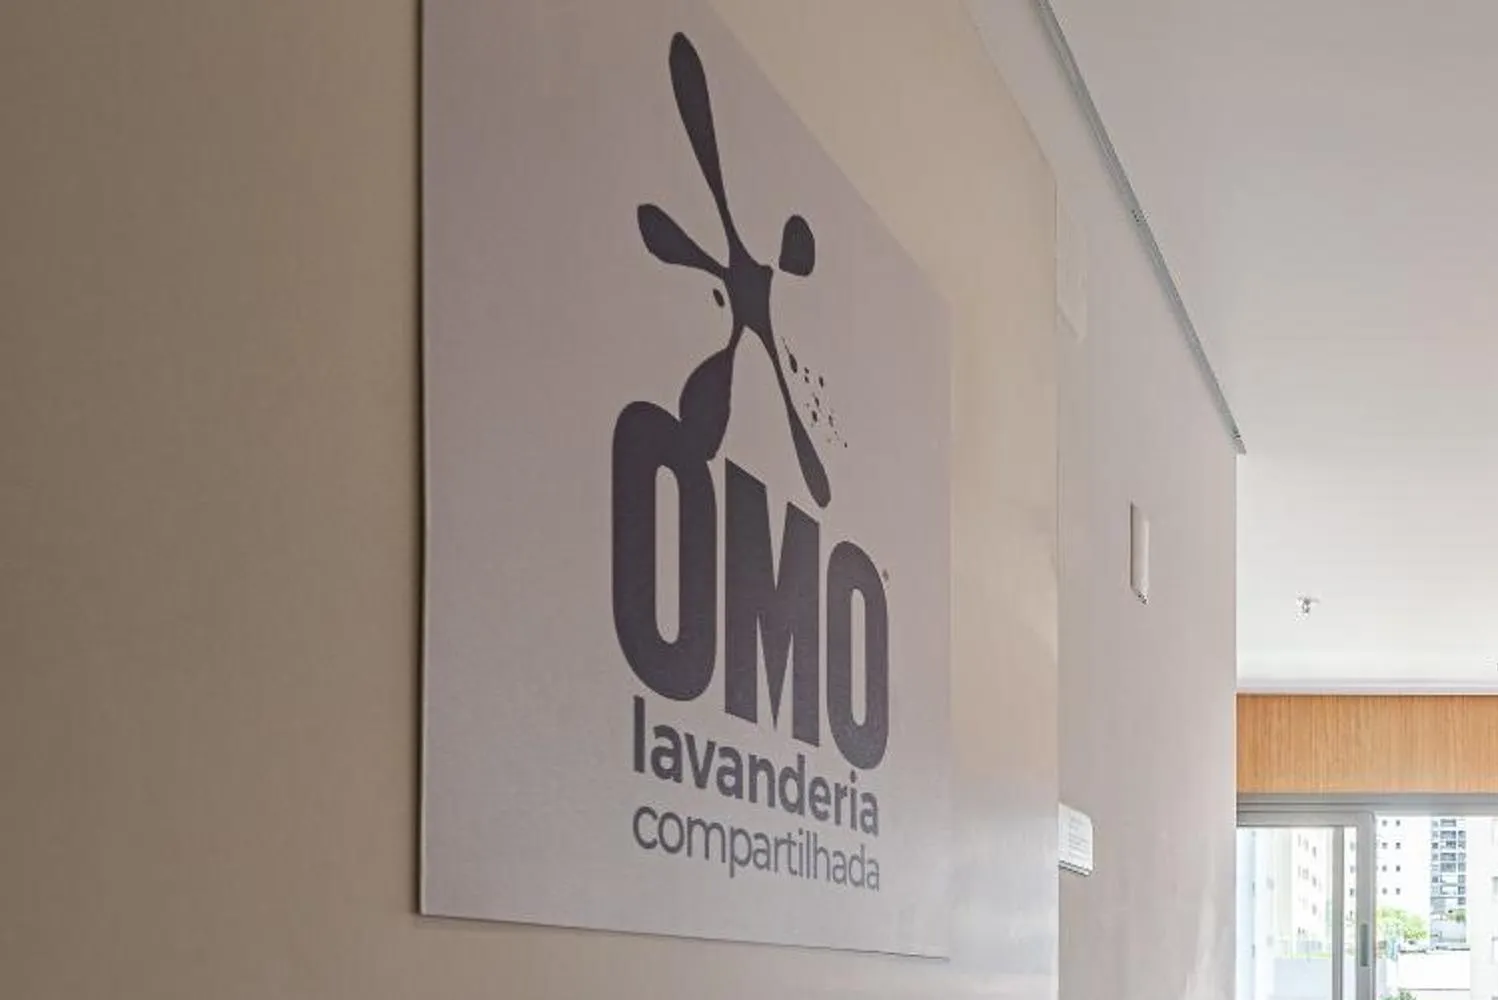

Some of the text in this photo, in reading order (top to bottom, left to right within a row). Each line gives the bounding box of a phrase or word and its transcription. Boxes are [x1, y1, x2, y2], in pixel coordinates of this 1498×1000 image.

[612, 401, 889, 770] OMO
[632, 696, 880, 836] lavanderia
[632, 804, 881, 892] compartilhada
